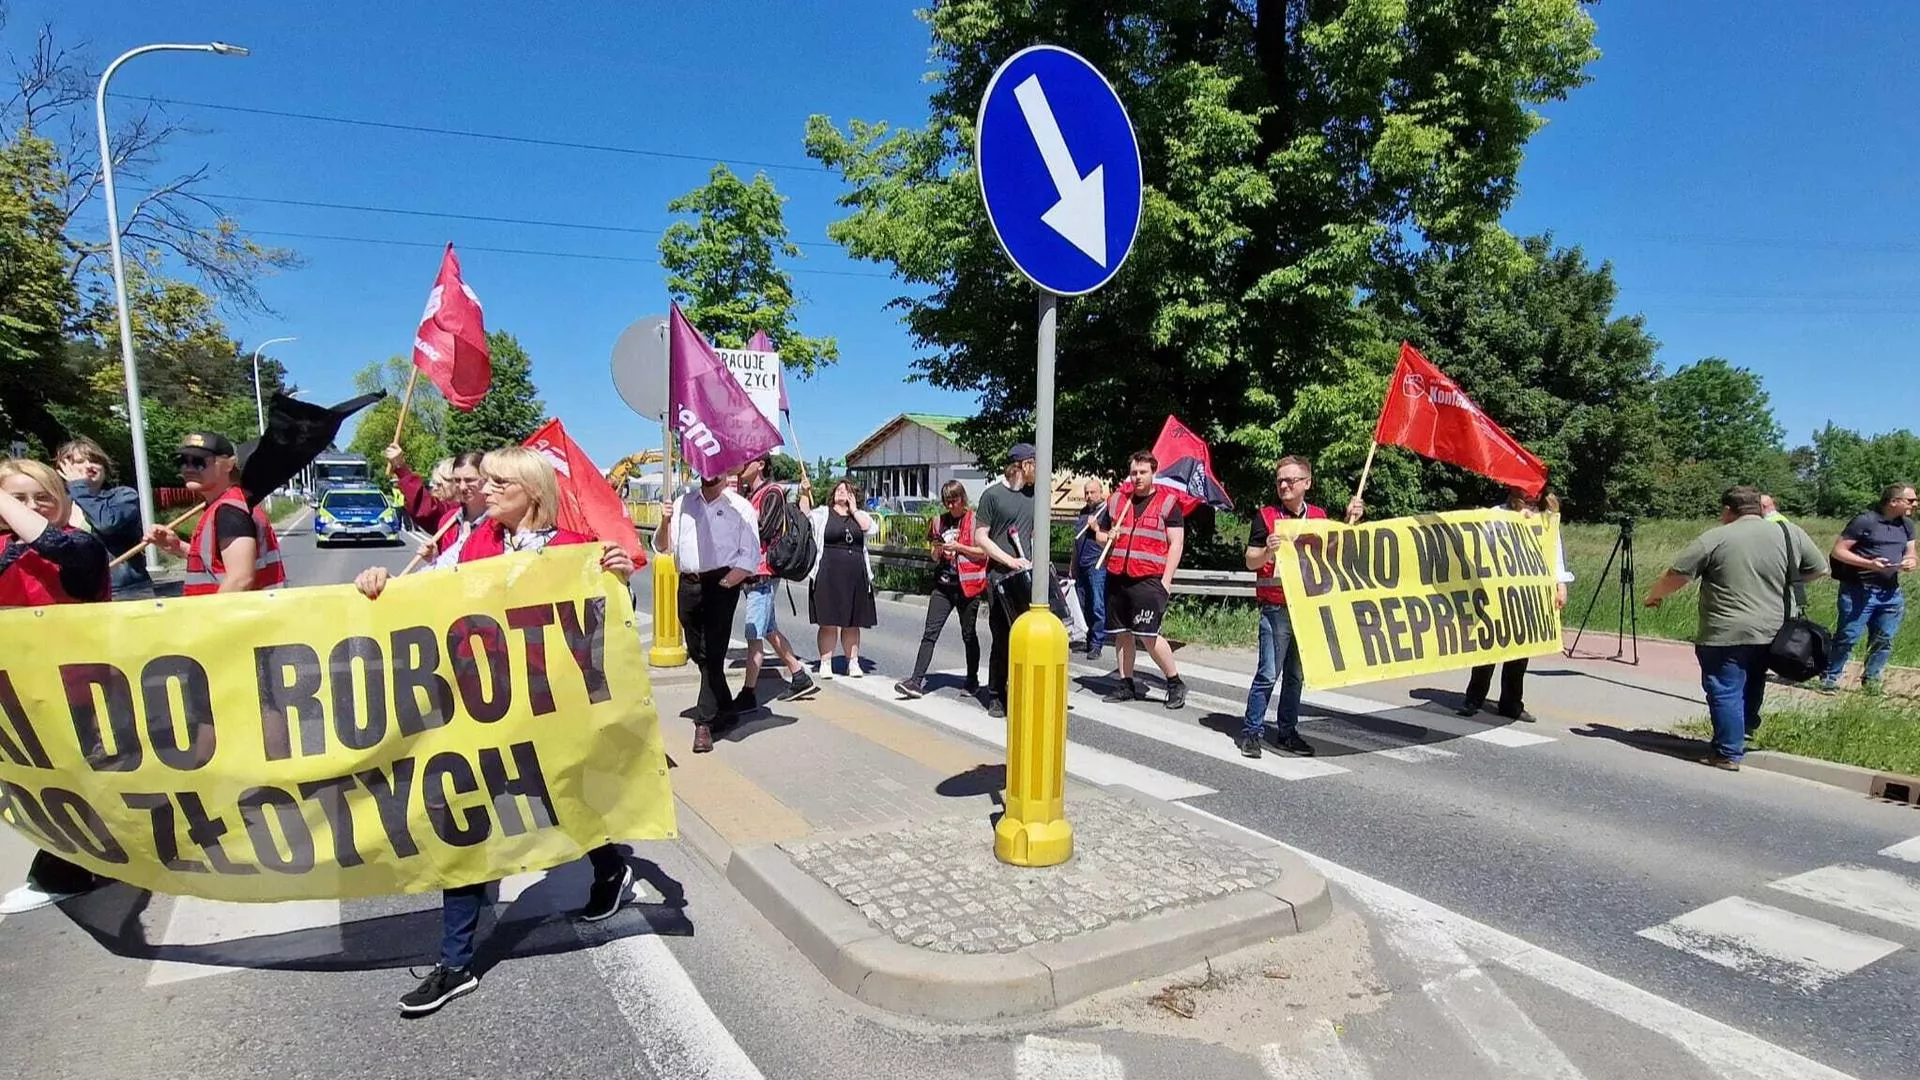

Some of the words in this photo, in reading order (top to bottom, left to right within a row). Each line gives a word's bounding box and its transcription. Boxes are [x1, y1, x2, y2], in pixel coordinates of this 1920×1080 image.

[1294, 527, 1399, 597] DINO
[58, 654, 217, 772] DO
[253, 596, 612, 762] ROBOTY
[1319, 605, 1346, 672] I
[120, 740, 560, 875] ZŁOTYCH
